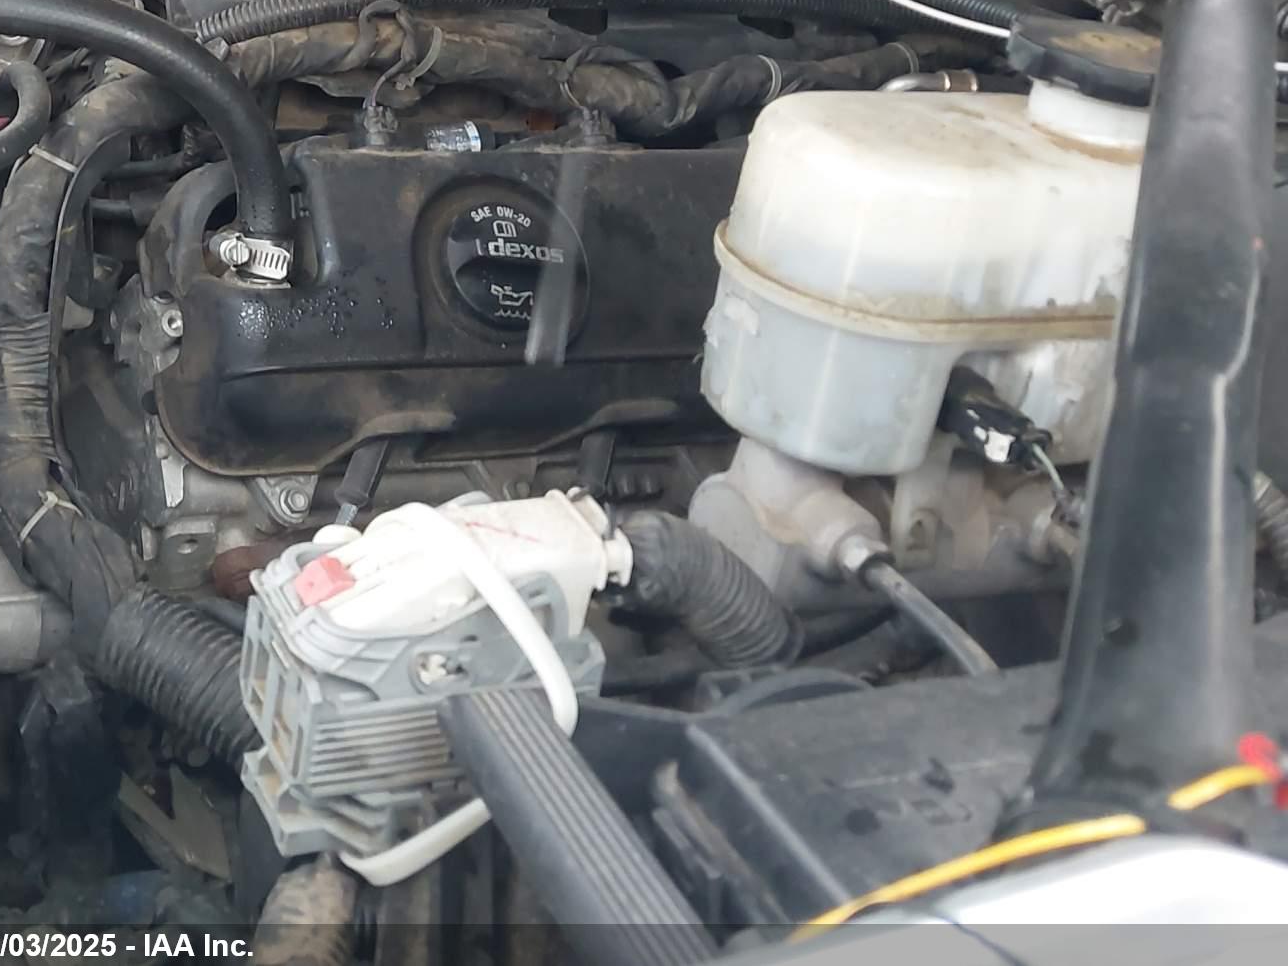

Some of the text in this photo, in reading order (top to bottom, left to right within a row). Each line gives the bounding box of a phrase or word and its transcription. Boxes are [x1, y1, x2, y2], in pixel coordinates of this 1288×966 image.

[471, 206, 531, 227] SAE 0W-20
[488, 238, 564, 263] dexos
